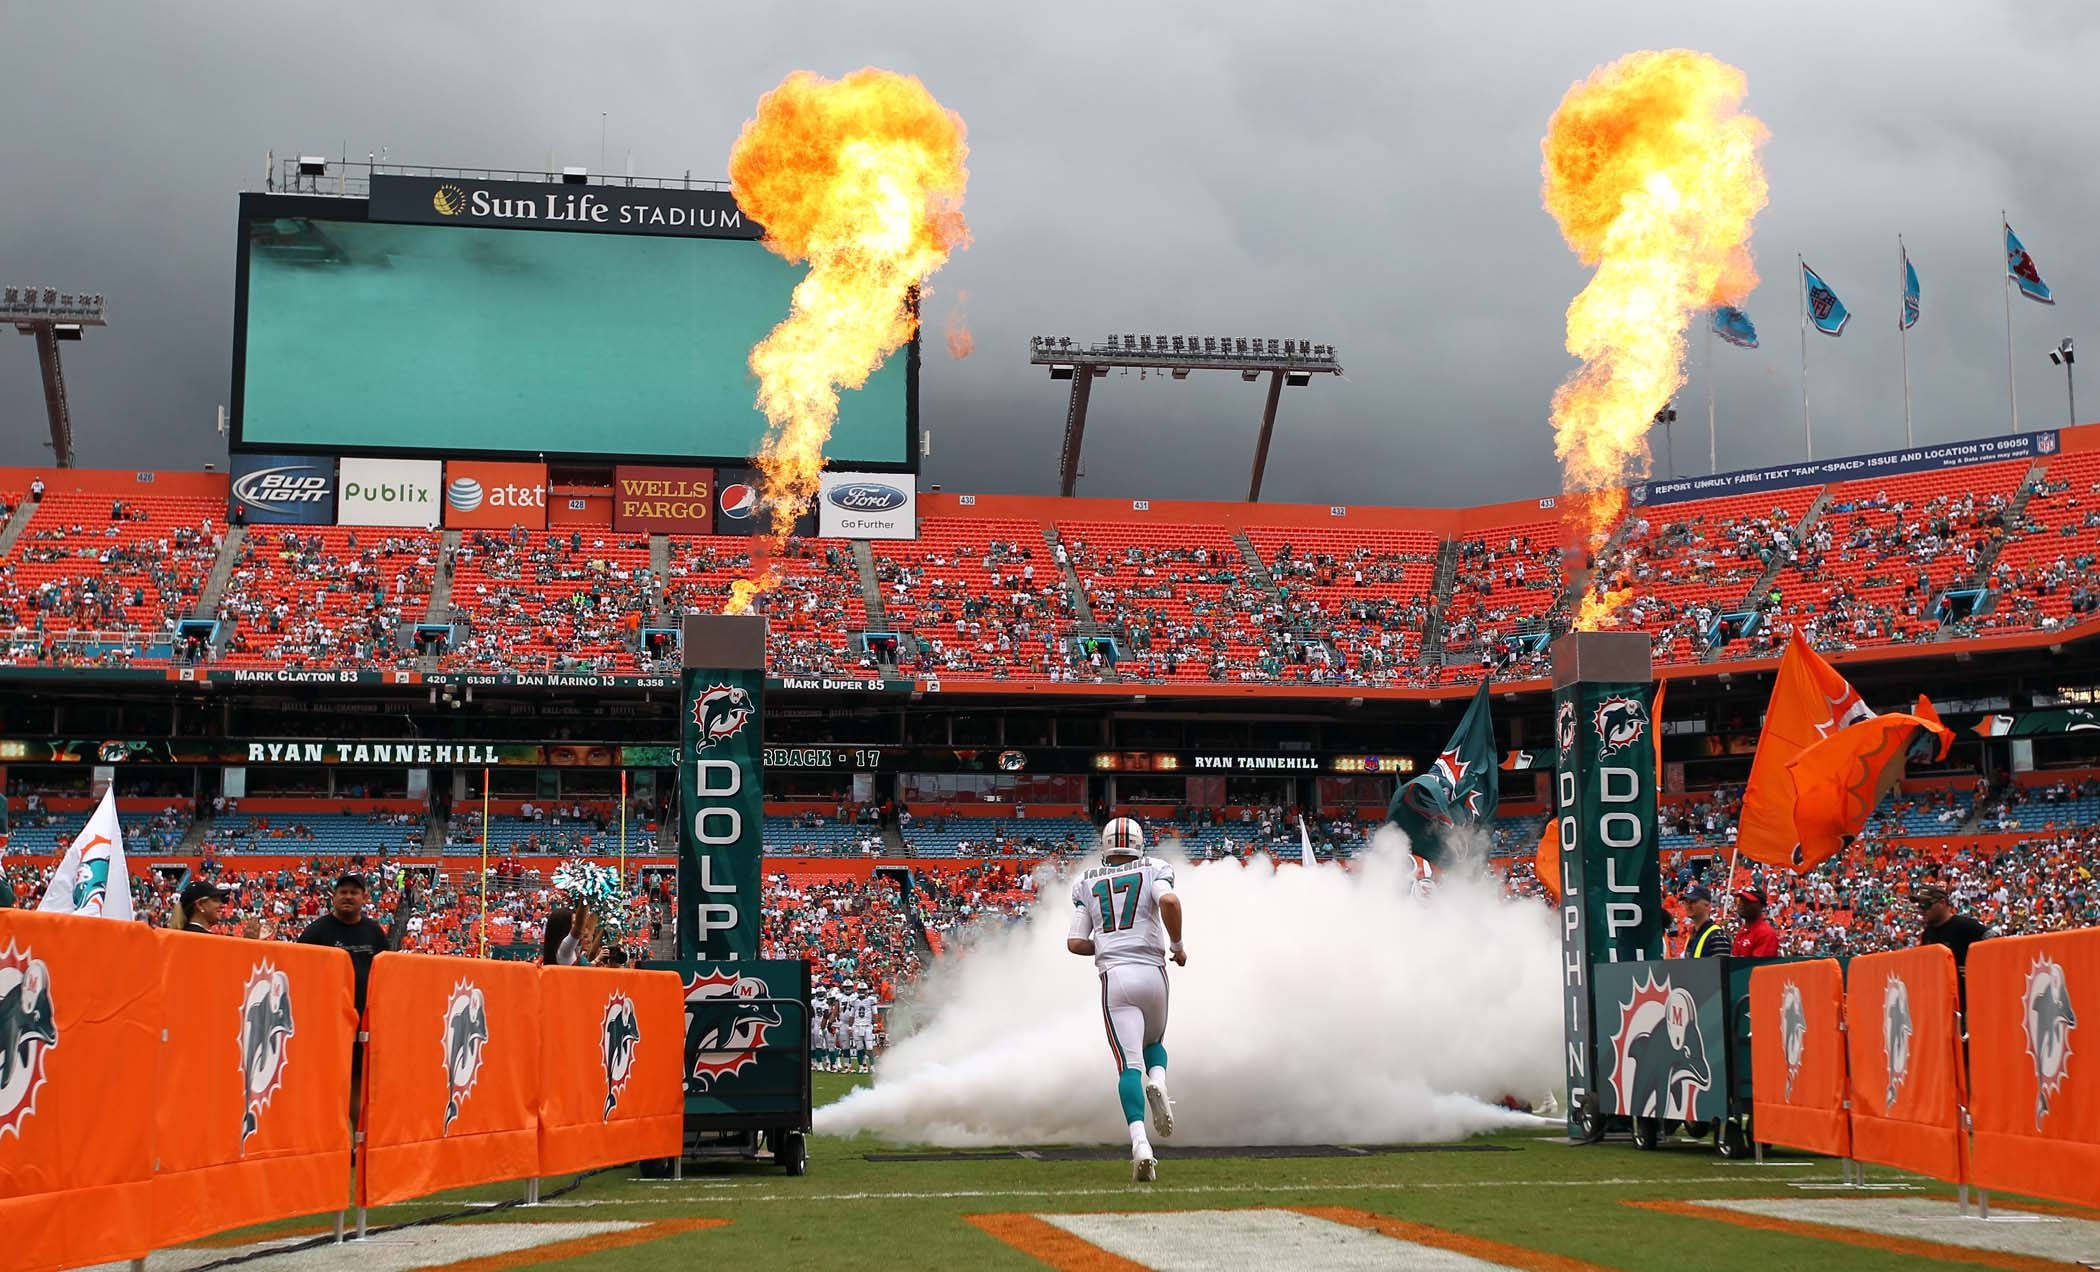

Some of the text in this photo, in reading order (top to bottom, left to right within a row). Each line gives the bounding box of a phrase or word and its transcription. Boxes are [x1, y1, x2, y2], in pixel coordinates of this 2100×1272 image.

[471, 190, 741, 228] Sun Life STADIUM
[1655, 482, 1691, 495] REPORT
[1694, 477, 1732, 489] UNRULY
[1764, 469, 1790, 480] TEXT
[1791, 465, 1819, 476] "FAN"
[1822, 460, 1865, 473] <SPACE>
[1867, 456, 1898, 467] ISSUE
[1900, 453, 1922, 463] AND
[1924, 445, 1977, 460] LOCATION
[1980, 443, 1994, 453] TO
[1997, 438, 2029, 449] 69050
[261, 474, 326, 489] BUD
[621, 480, 708, 498] WELLS
[249, 486, 330, 502] LIGHT
[345, 482, 428, 503] Publix
[489, 483, 545, 507] at&t
[841, 486, 890, 508] Ford
[569, 500, 585, 509] 428
[960, 496, 975, 505] 430
[1134, 502, 1149, 510] 431
[1540, 499, 1554, 508] 433
[623, 501, 706, 519] FARGO
[1332, 507, 1345, 516] 432
[841, 519, 895, 530] Go Further
[235, 671, 358, 682] MARK CLAYTON 83
[427, 676, 447, 684] 420
[517, 675, 615, 687] DAN MARINO 13
[783, 678, 885, 691] MARK DUPER 85
[249, 743, 499, 763] RYAN TANNEHILL
[856, 750, 880, 767] 17
[1195, 756, 1319, 769] RYAN TANNEHILL
[1092, 872, 1143, 933] 17
[740, 986, 752, 996] M
[1671, 1007, 1684, 1027] M
